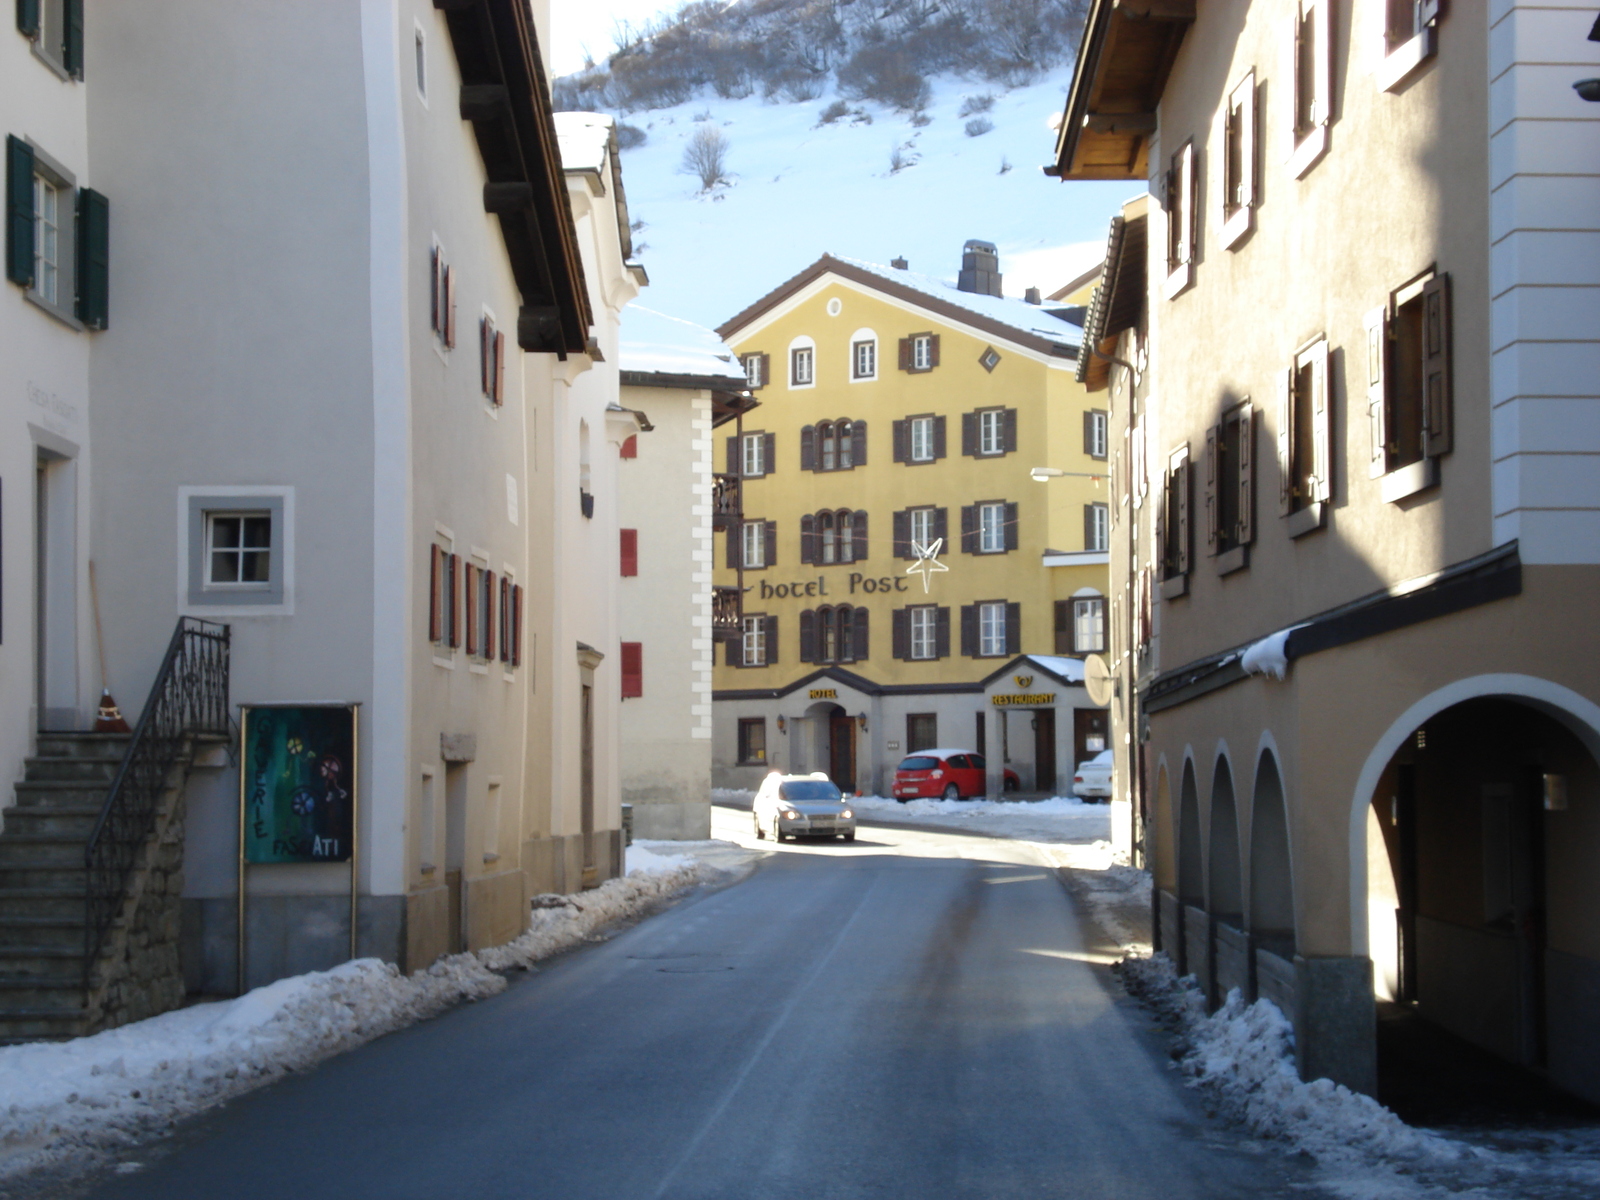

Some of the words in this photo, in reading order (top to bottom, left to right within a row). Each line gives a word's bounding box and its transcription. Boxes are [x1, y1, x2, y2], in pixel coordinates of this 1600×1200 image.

[849, 573, 908, 594] Post
[808, 689, 838, 699] HOTEL
[991, 693, 1056, 705] RESTAURANT
